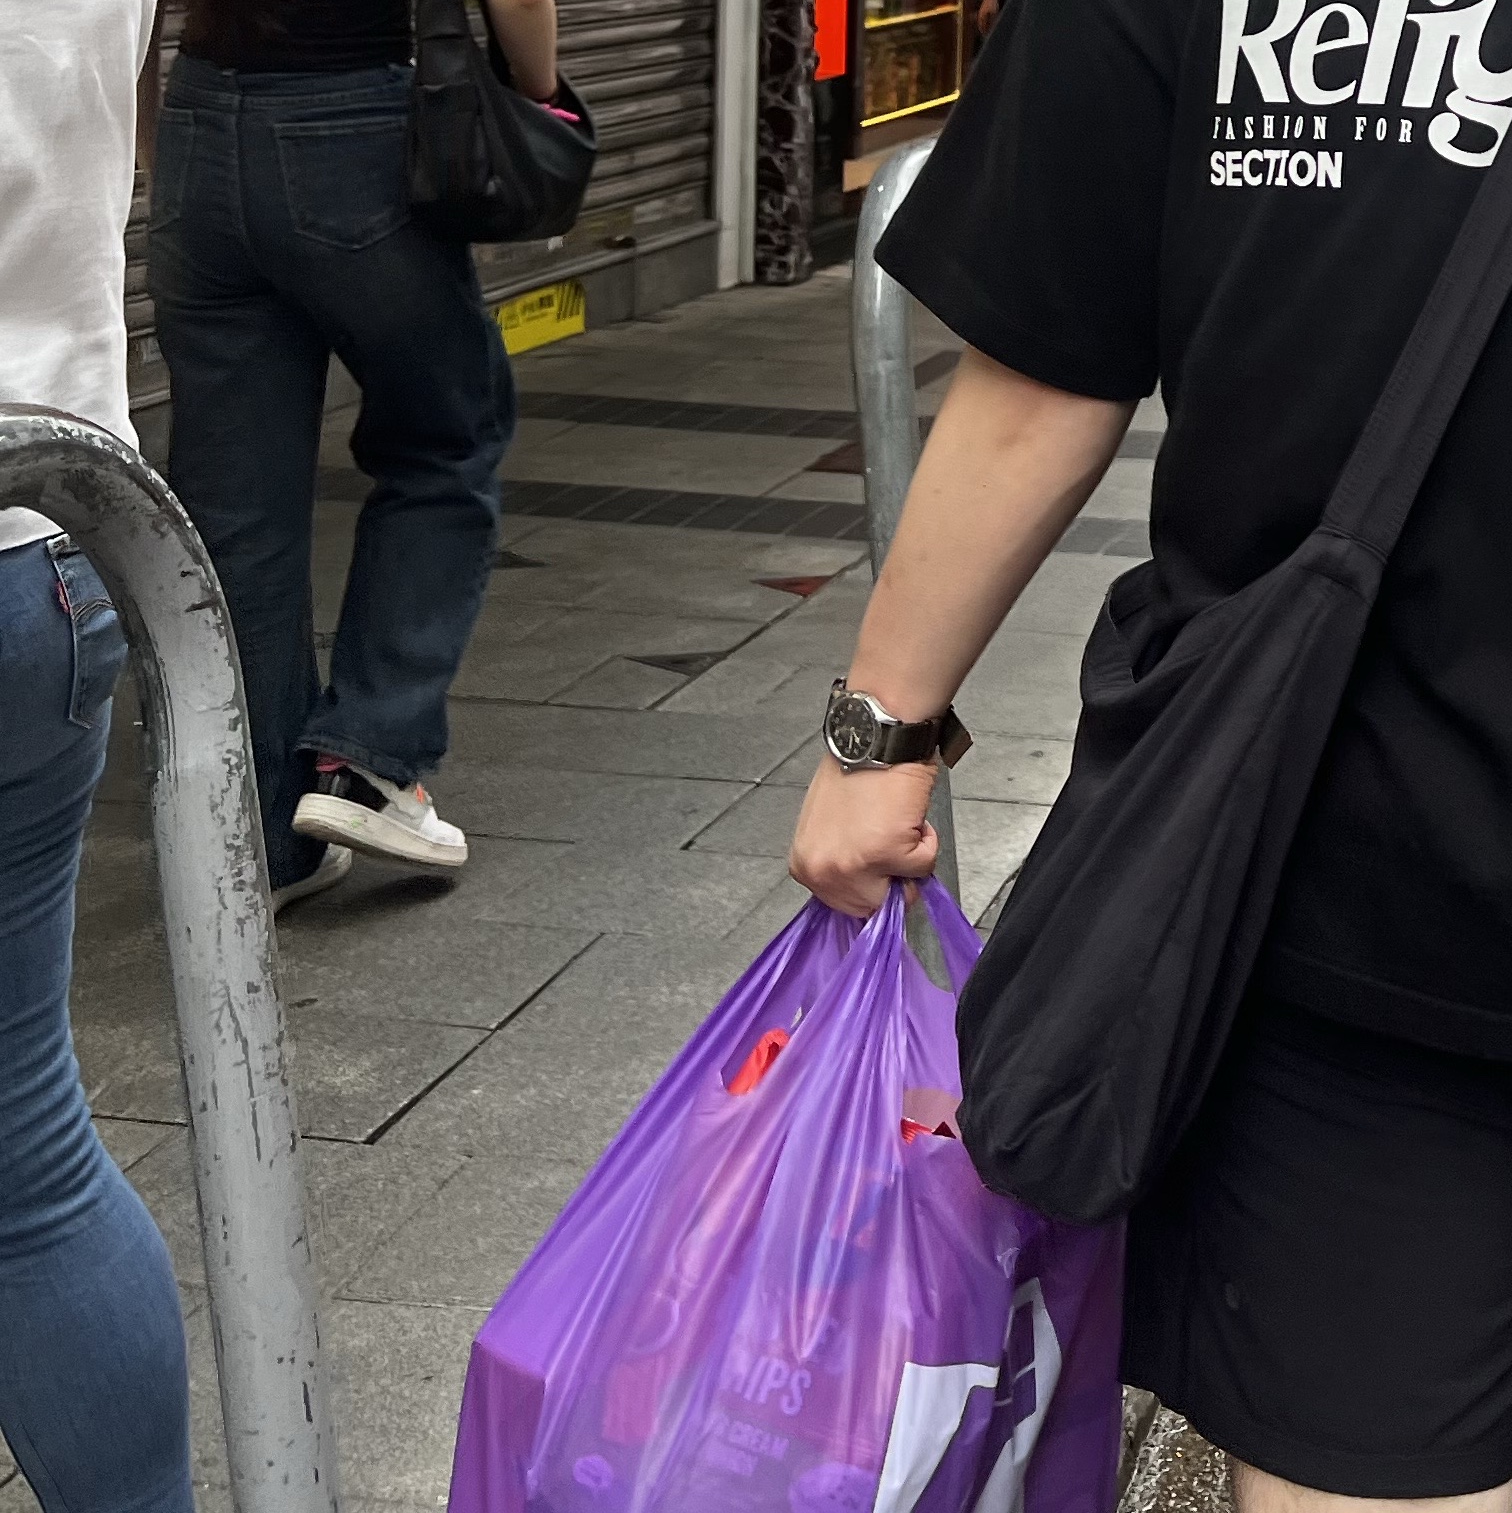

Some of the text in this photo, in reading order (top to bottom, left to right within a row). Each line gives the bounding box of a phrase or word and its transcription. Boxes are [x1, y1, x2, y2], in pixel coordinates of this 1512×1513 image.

[1212, 115, 1327, 140] FASHION
[1354, 116, 1413, 144] FOR
[1210, 149, 1343, 188] SECTION
